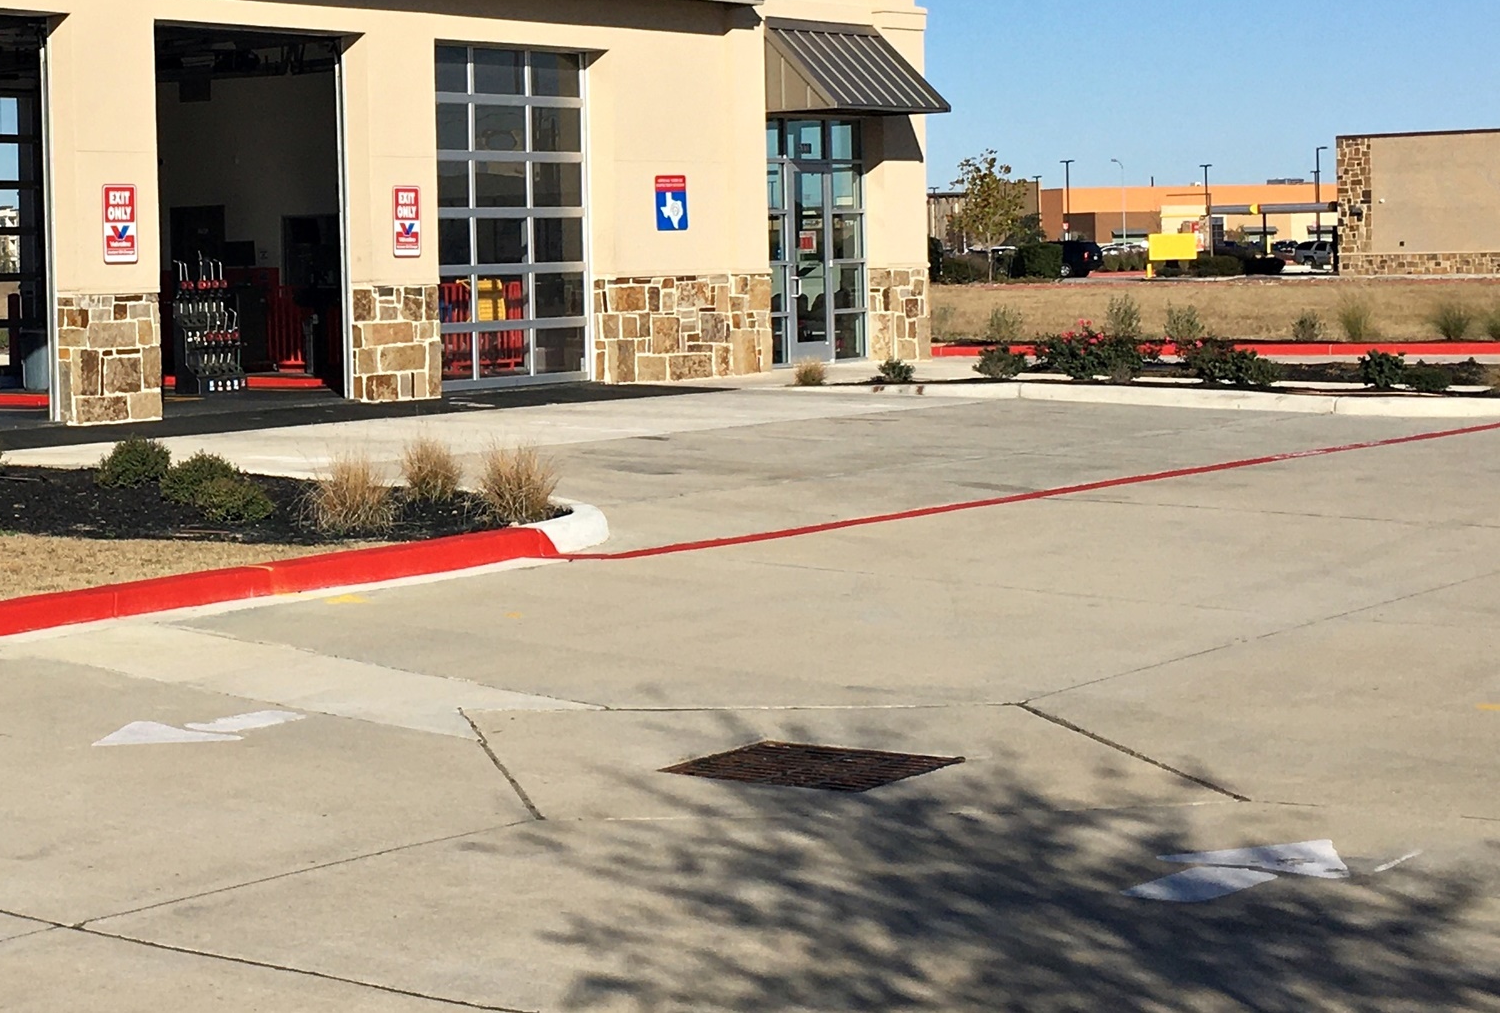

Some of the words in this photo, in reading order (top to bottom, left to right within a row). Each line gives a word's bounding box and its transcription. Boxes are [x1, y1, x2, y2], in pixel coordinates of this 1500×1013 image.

[108, 190, 131, 205] EXIT
[398, 191, 416, 205] EXIT
[107, 205, 132, 221] ONLY
[396, 204, 417, 219] ONLY
